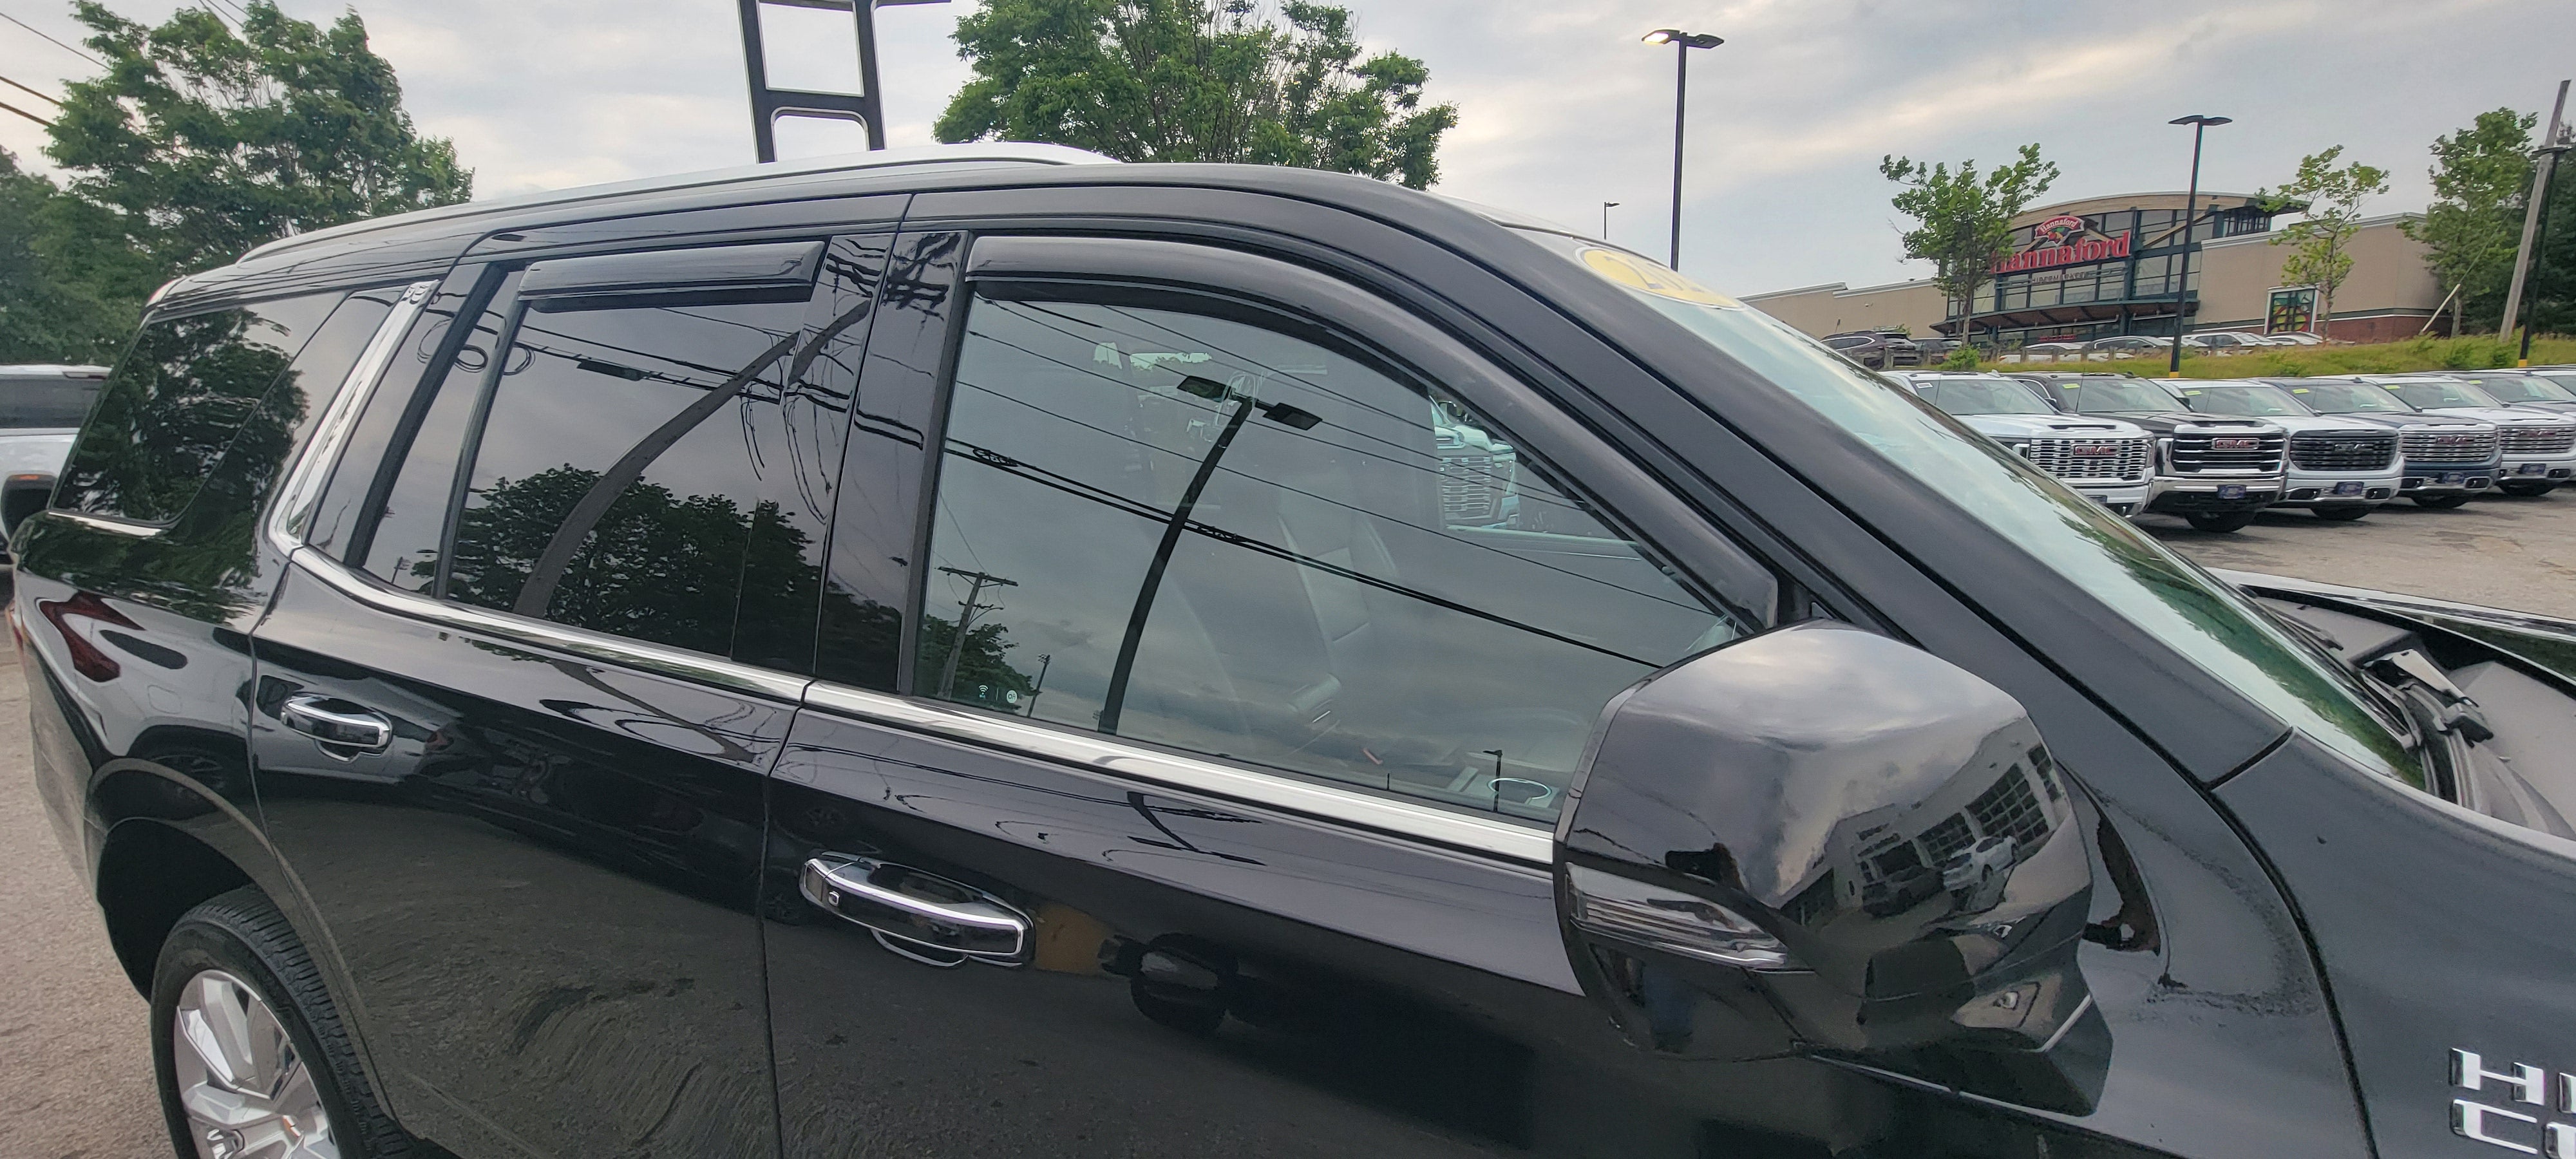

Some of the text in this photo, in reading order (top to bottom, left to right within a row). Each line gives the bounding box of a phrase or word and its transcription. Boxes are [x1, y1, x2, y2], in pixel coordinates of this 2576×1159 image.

[2040, 218, 2079, 232] Hannaford
[2216, 440, 2259, 448] GMC
[2075, 446, 2119, 455] GMC
